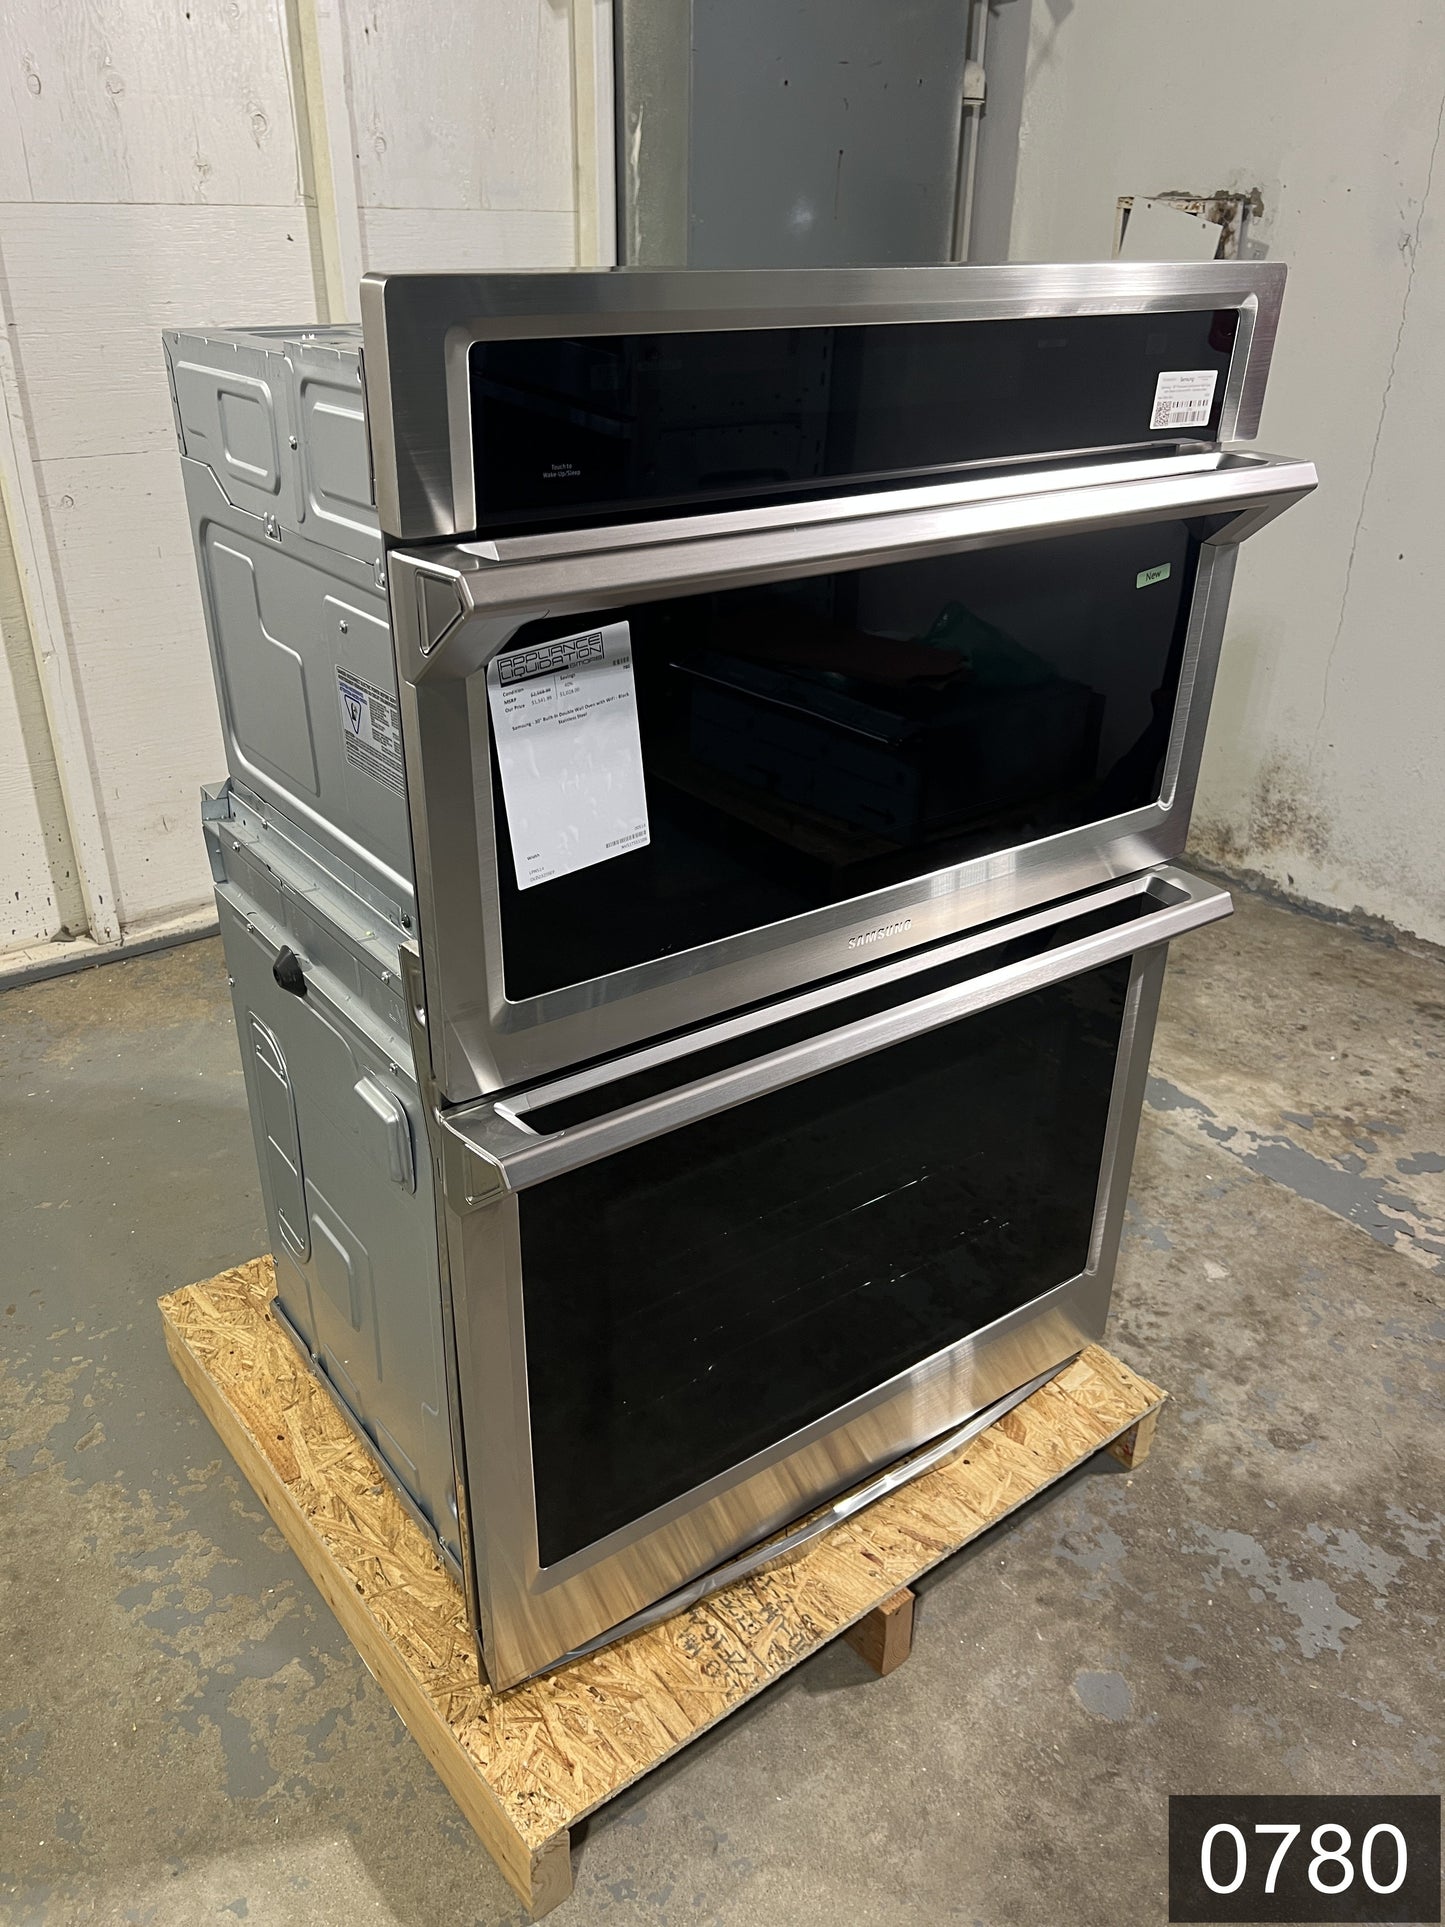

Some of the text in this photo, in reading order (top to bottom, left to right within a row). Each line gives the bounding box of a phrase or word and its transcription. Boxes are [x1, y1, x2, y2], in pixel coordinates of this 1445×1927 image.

[1145, 571, 1162, 581] New
[500, 634, 601, 671] APPLIANCE
[500, 644, 602, 680] LIQUIDATION
[502, 687, 525, 698] Condition
[504, 706, 514, 714] Our
[514, 703, 526, 711] Price
[512, 722, 532, 732] Samsung
[558, 708, 575, 718] Double
[584, 702, 596, 711] Oven
[596, 699, 606, 707] with
[618, 691, 630, 700] Black
[576, 711, 588, 720] Steel
[848, 919, 912, 949] SAMSUNG
